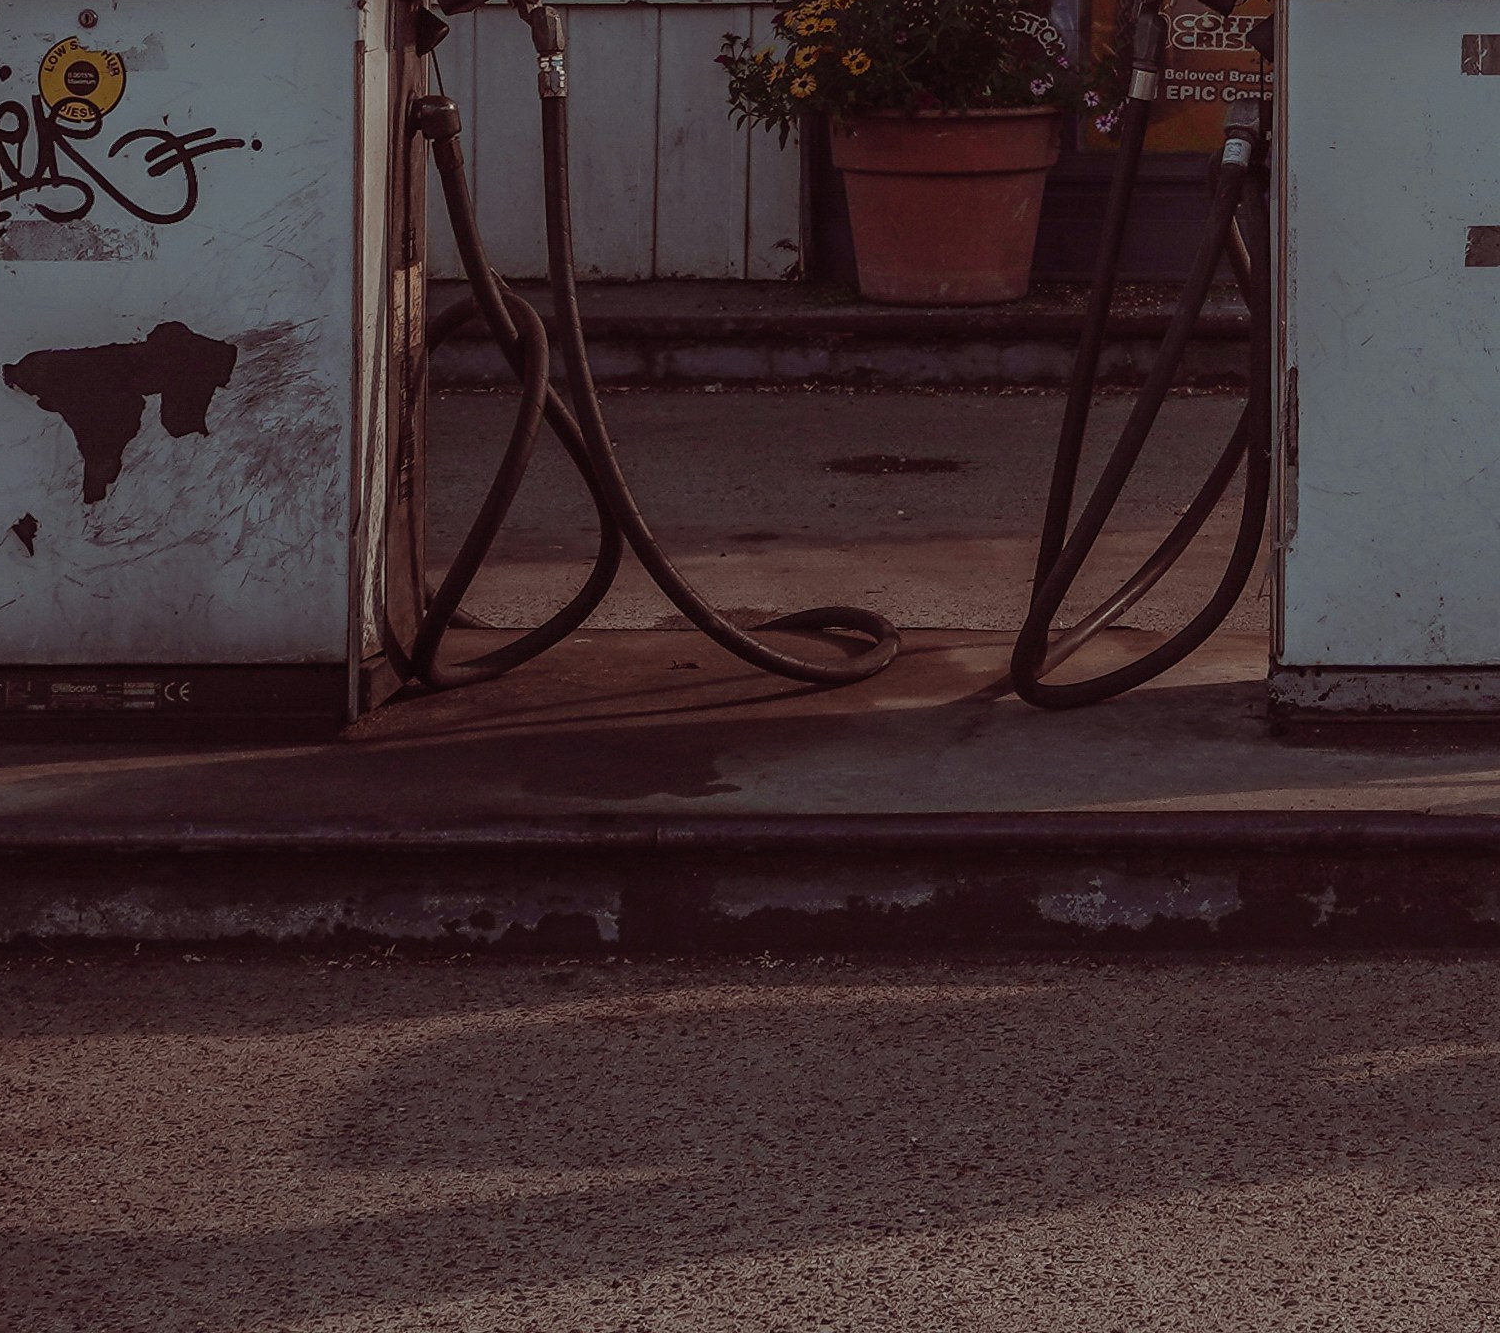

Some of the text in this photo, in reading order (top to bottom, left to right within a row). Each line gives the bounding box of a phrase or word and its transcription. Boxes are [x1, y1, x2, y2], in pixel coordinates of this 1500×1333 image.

[1171, 32, 1256, 51] CRIS
[44, 45, 67, 73] LOW
[1164, 68, 1224, 81] Beloved
[1166, 85, 1215, 101] EPIC
